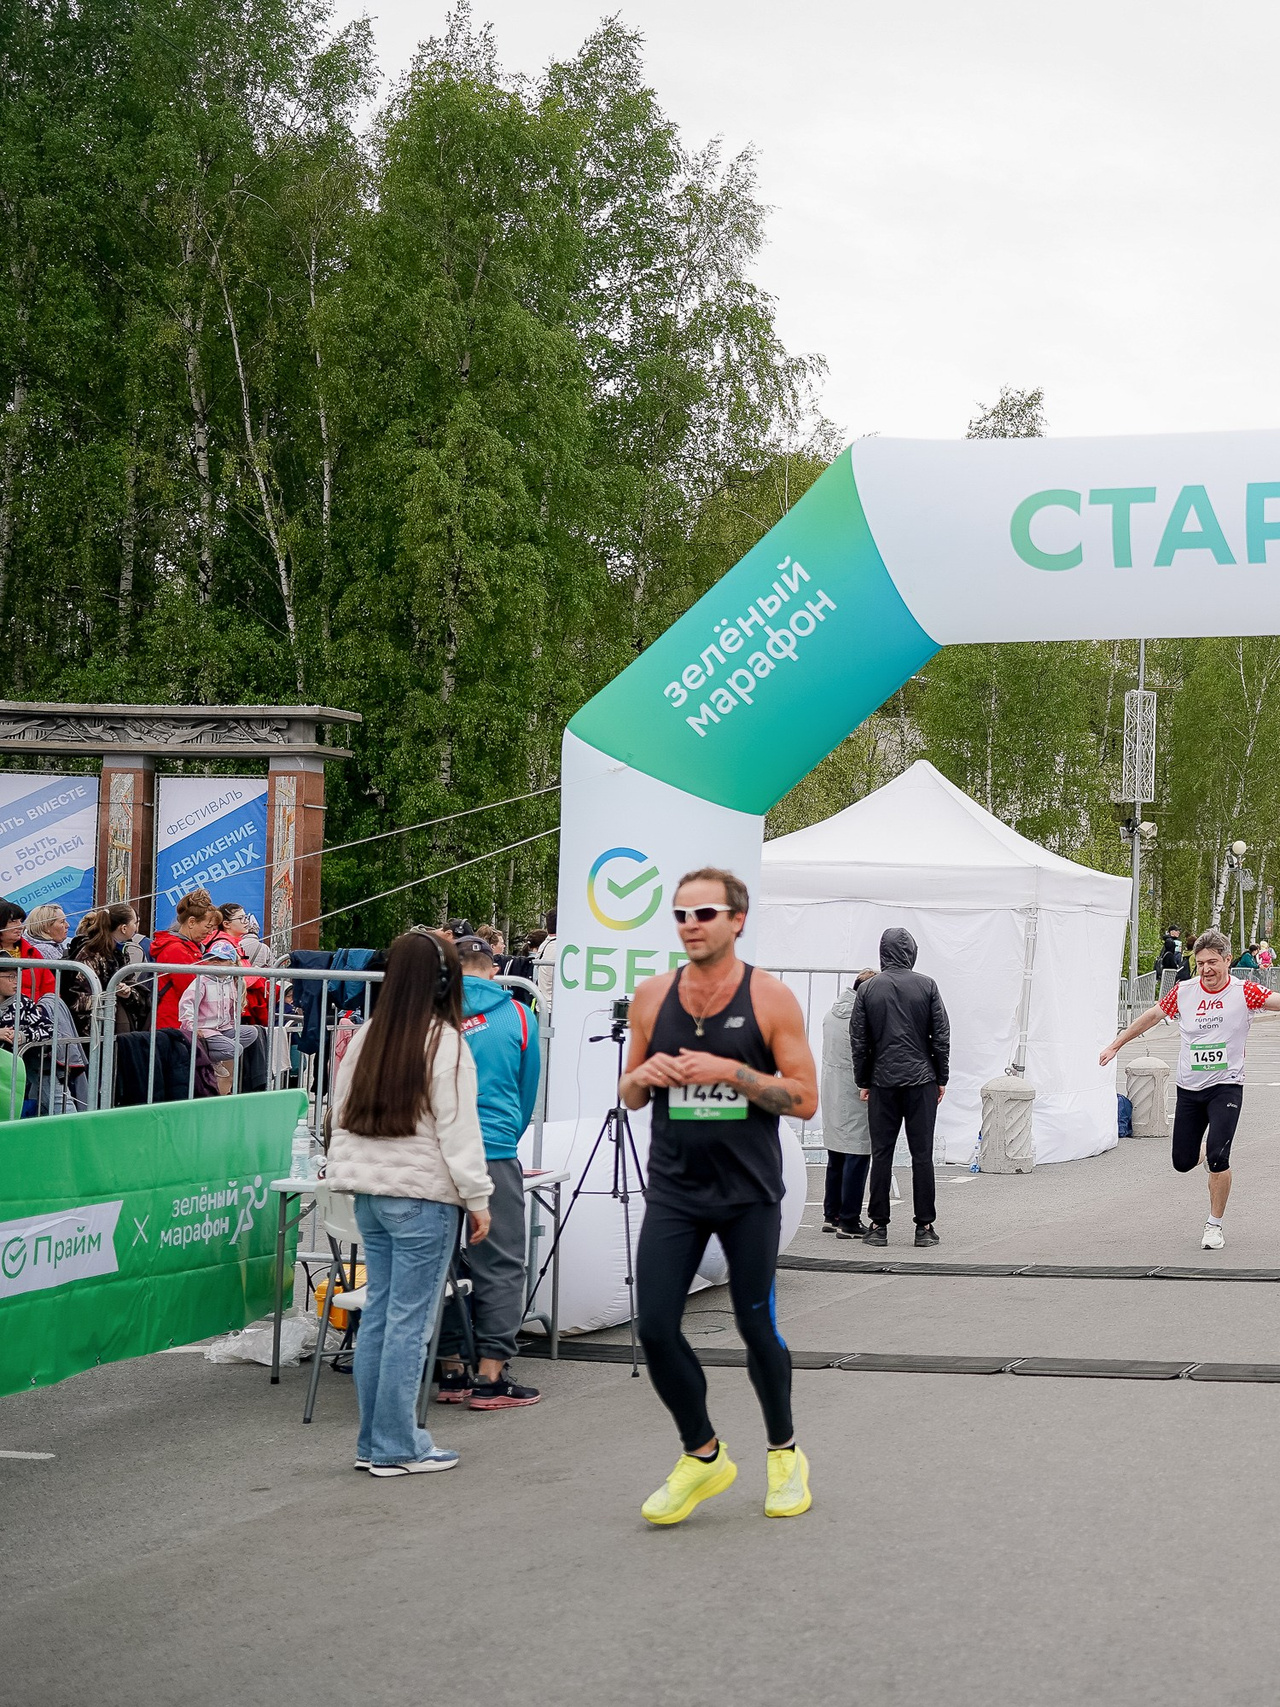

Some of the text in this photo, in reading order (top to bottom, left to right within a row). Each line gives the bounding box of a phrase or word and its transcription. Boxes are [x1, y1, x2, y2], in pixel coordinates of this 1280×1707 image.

[663, 556, 812, 708] зелёный
[686, 588, 838, 738] марафон
[26, 785, 88, 821] ВМЕСТЕ
[166, 789, 243, 836] ФЕСТИВАЛЬ
[1, 834, 85, 882] С РОССИЕЙ
[15, 835, 58, 861] БЫТЬ
[170, 820, 258, 879] ДВИЖЕНИЕ
[1194, 1050, 1223, 1063] 1459
[171, 1181, 239, 1219] зелёный
[33, 1225, 102, 1269] Прайм
[160, 1213, 230, 1250] марафон
